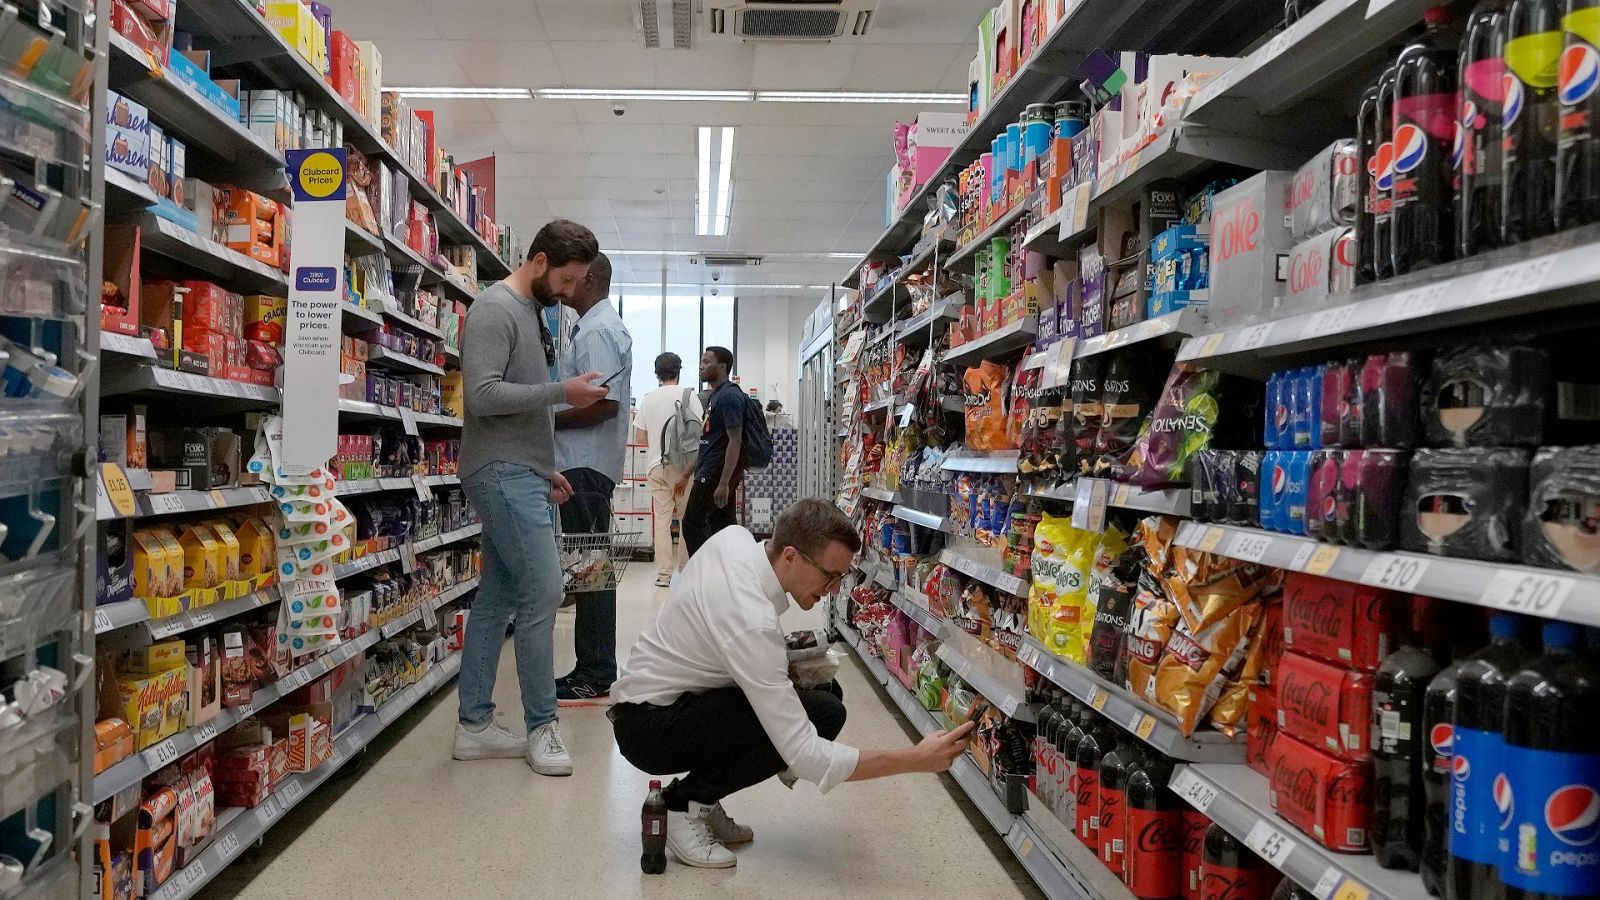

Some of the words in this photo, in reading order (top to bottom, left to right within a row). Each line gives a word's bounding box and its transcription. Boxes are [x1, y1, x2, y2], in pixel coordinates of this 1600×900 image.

[302, 168, 339, 176] Clubcard
[308, 176, 333, 184] Prices
[1210, 199, 1259, 263] Coke
[1290, 248, 1322, 294] Coke
[291, 300, 308, 308] The
[310, 302, 338, 310] power
[296, 311, 306, 319] to
[307, 311, 333, 319] lower
[299, 321, 330, 330] prices.
[107, 478, 127, 492] £1.25
[1380, 558, 1419, 587] £10
[1507, 576, 1560, 611] £10
[157, 741, 175, 763] £1.15
[1187, 781, 1215, 807] £4.70
[1454, 782, 1467, 834] pepsi
[221, 831, 239, 854] £1.15
[1260, 831, 1287, 859] £5
[184, 861, 204, 883] £2.55
